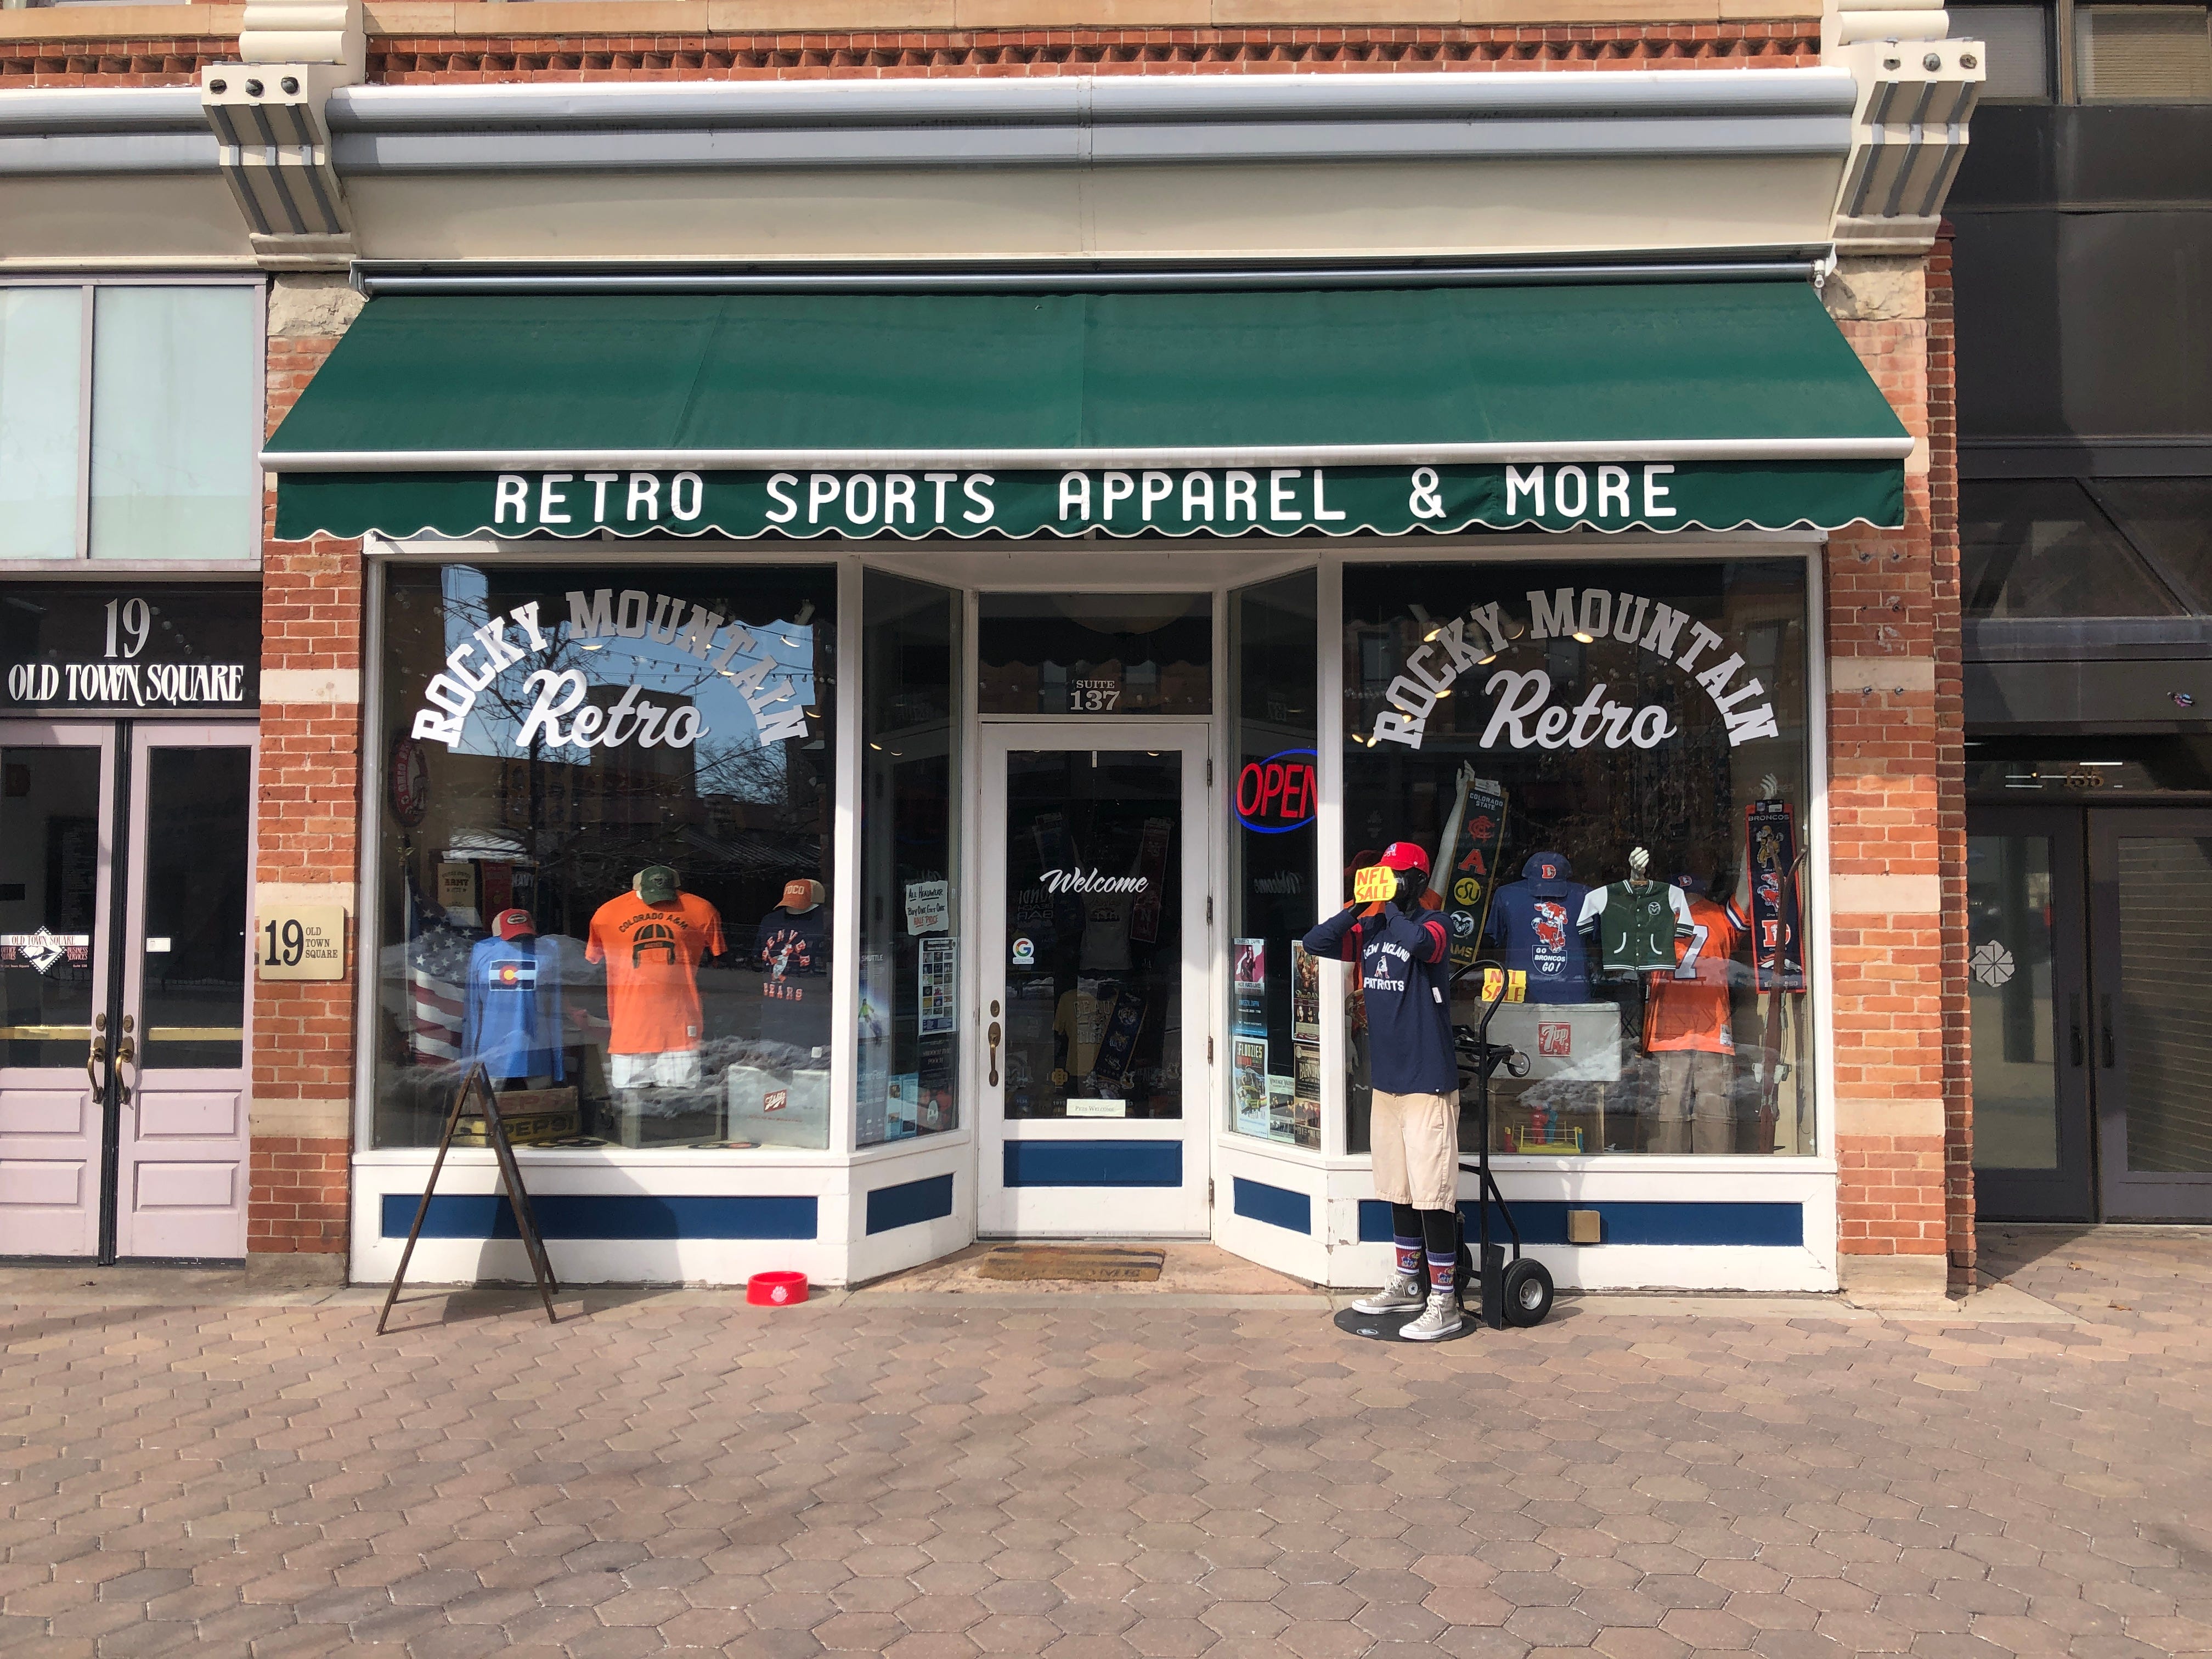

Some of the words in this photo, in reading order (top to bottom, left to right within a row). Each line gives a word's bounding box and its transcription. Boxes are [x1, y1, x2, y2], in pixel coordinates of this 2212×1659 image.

[494, 472, 703, 524] RETRO
[766, 472, 995, 525] SPORTS
[1059, 469, 1346, 522] APPAREL
[1410, 467, 1446, 519] &
[1506, 465, 1677, 517] MORE
[104, 597, 150, 658] 19
[411, 601, 549, 748] ROCKY
[565, 589, 809, 747] MOUNTAIN
[1374, 601, 1509, 749] ROCKY
[1527, 587, 1779, 748] MOUNTAIN
[8, 664, 59, 701] OLD
[66, 664, 145, 707] TOWN
[146, 664, 244, 706] SQUARE
[1076, 680, 1115, 689] SUITE
[1070, 690, 1120, 710] 137
[516, 669, 709, 749] Retro
[1479, 669, 1677, 749] Retro
[1470, 793, 1503, 807] COLORADO
[1476, 800, 1496, 811] STATE
[1039, 867, 1149, 894] Welcome
[1357, 867, 1389, 887] NFL
[909, 888, 917, 899] ALL
[1356, 885, 1392, 901] SALE
[306, 927, 321, 935] OLD
[618, 912, 664, 933] COLORADO
[667, 915, 688, 930] A&M
[12, 936, 25, 945] OLD
[27, 936, 48, 946] TOWN
[50, 936, 76, 946] SQUARE
[265, 919, 303, 966] 19
[306, 939, 330, 947] TOWN
[762, 929, 811, 967] DENVER
[67, 953, 88, 962] SERVICES
[306, 950, 338, 958] SQUARE
[1363, 943, 1380, 960] NEW
[1542, 962, 1561, 972] GO!
[1363, 977, 1404, 992] PATRIOTS
[1490, 970, 1519, 985] NL
